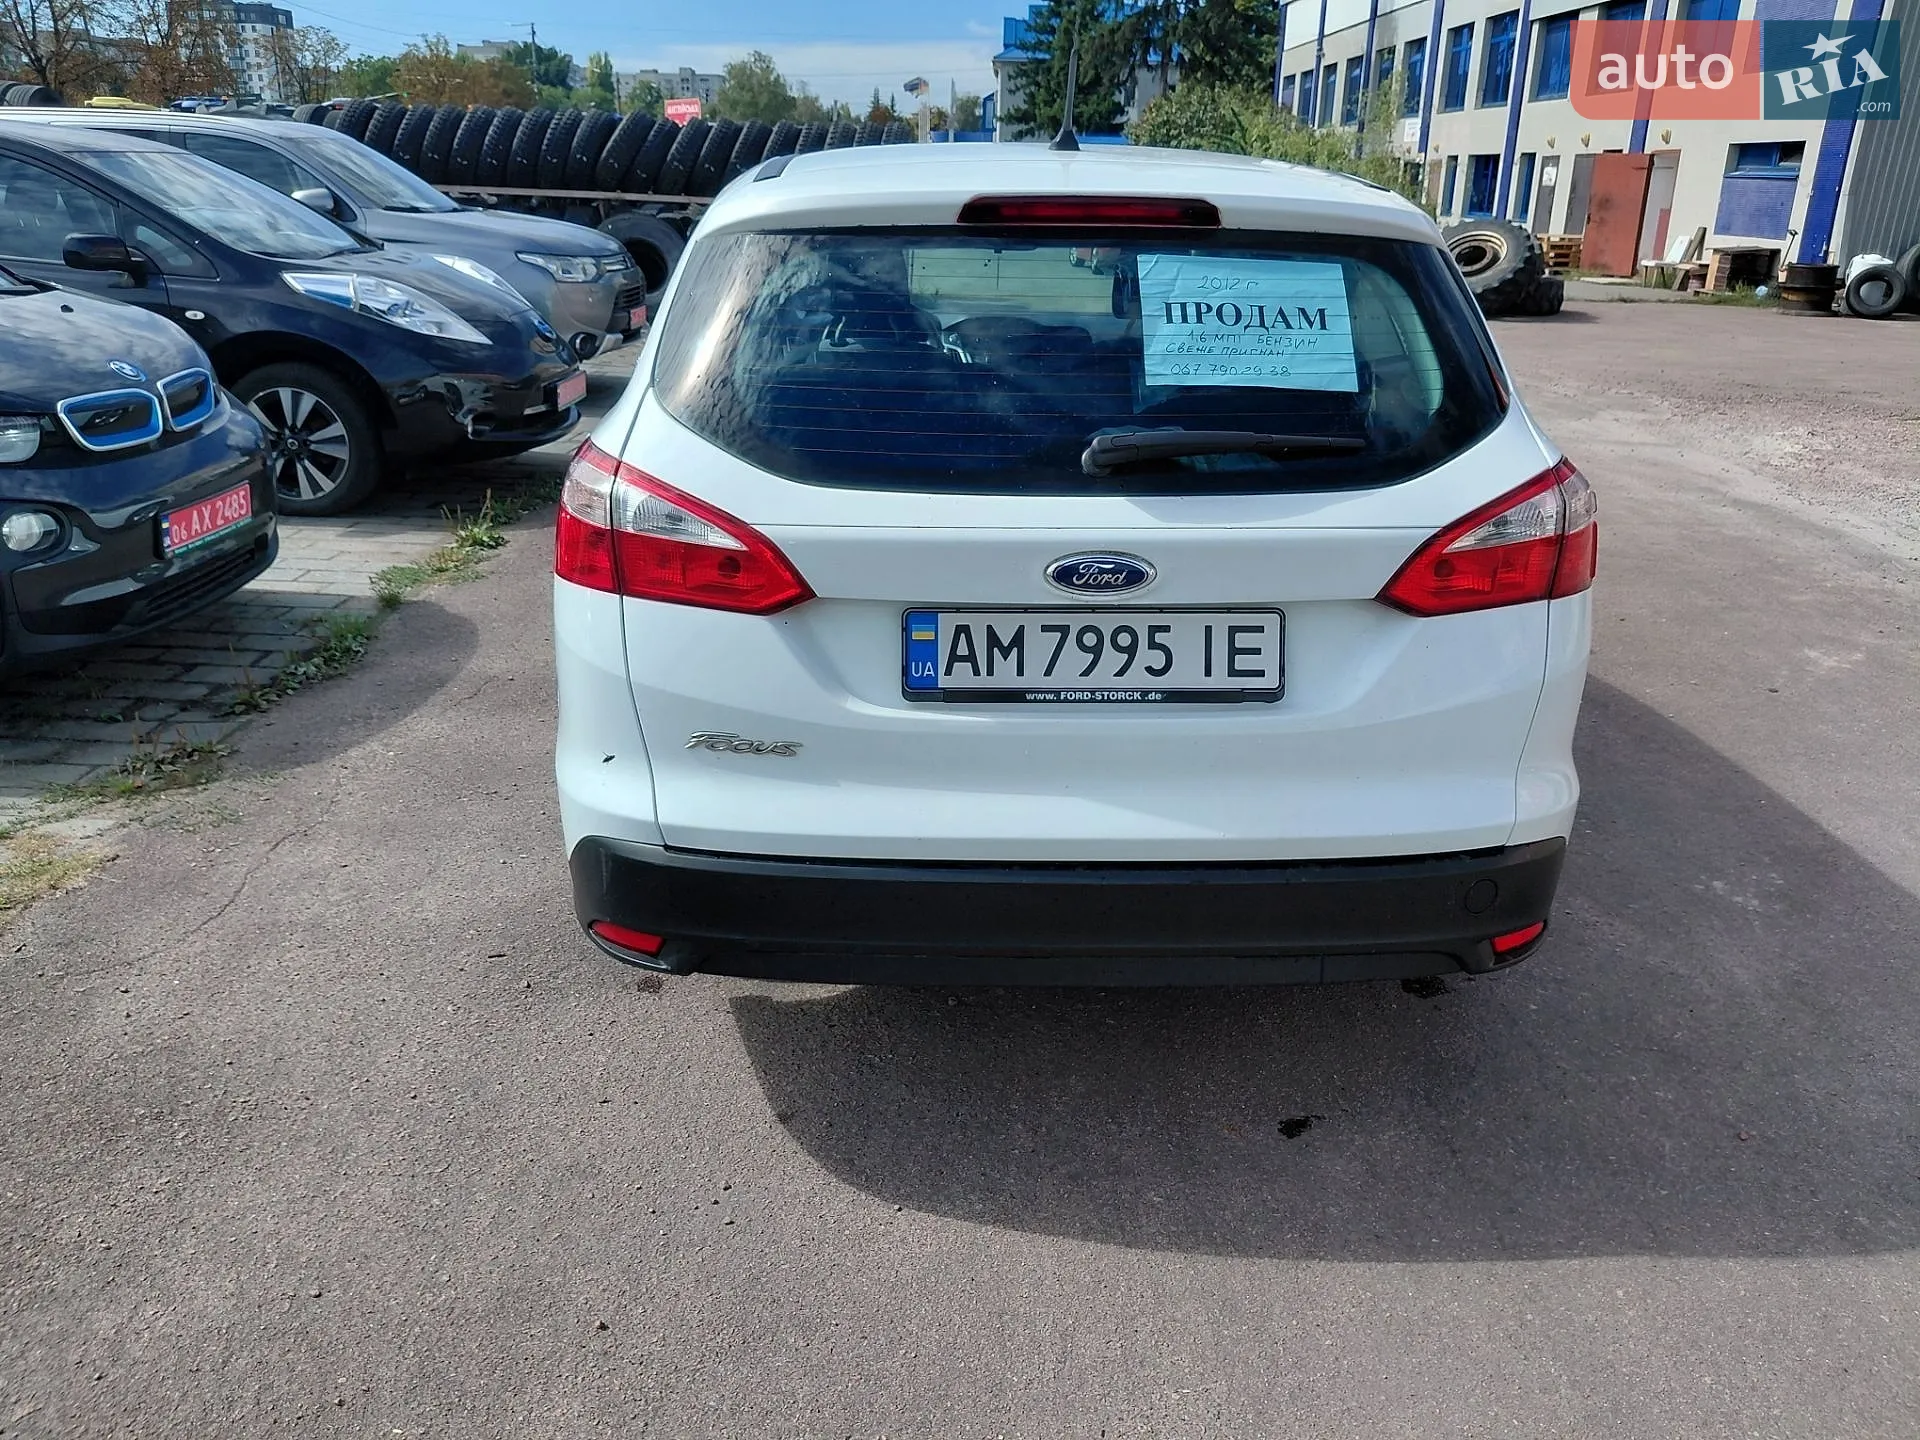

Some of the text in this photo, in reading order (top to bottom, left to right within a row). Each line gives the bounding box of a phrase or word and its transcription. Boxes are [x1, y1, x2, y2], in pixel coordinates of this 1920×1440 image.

[1197, 275, 1241, 290] 2012
[1163, 301, 1328, 334] ПРОДАМ
[1257, 334, 1319, 349] БЕНЗИН
[1170, 363, 1201, 376] 067
[172, 521, 188, 544] 06
[191, 504, 213, 536] AX
[215, 490, 248, 526] 2485
[1072, 562, 1128, 587] Ford
[943, 624, 1266, 678] AM 7995 IE
[911, 661, 935, 677] UA
[1060, 691, 1142, 701] FORD-STORCK
